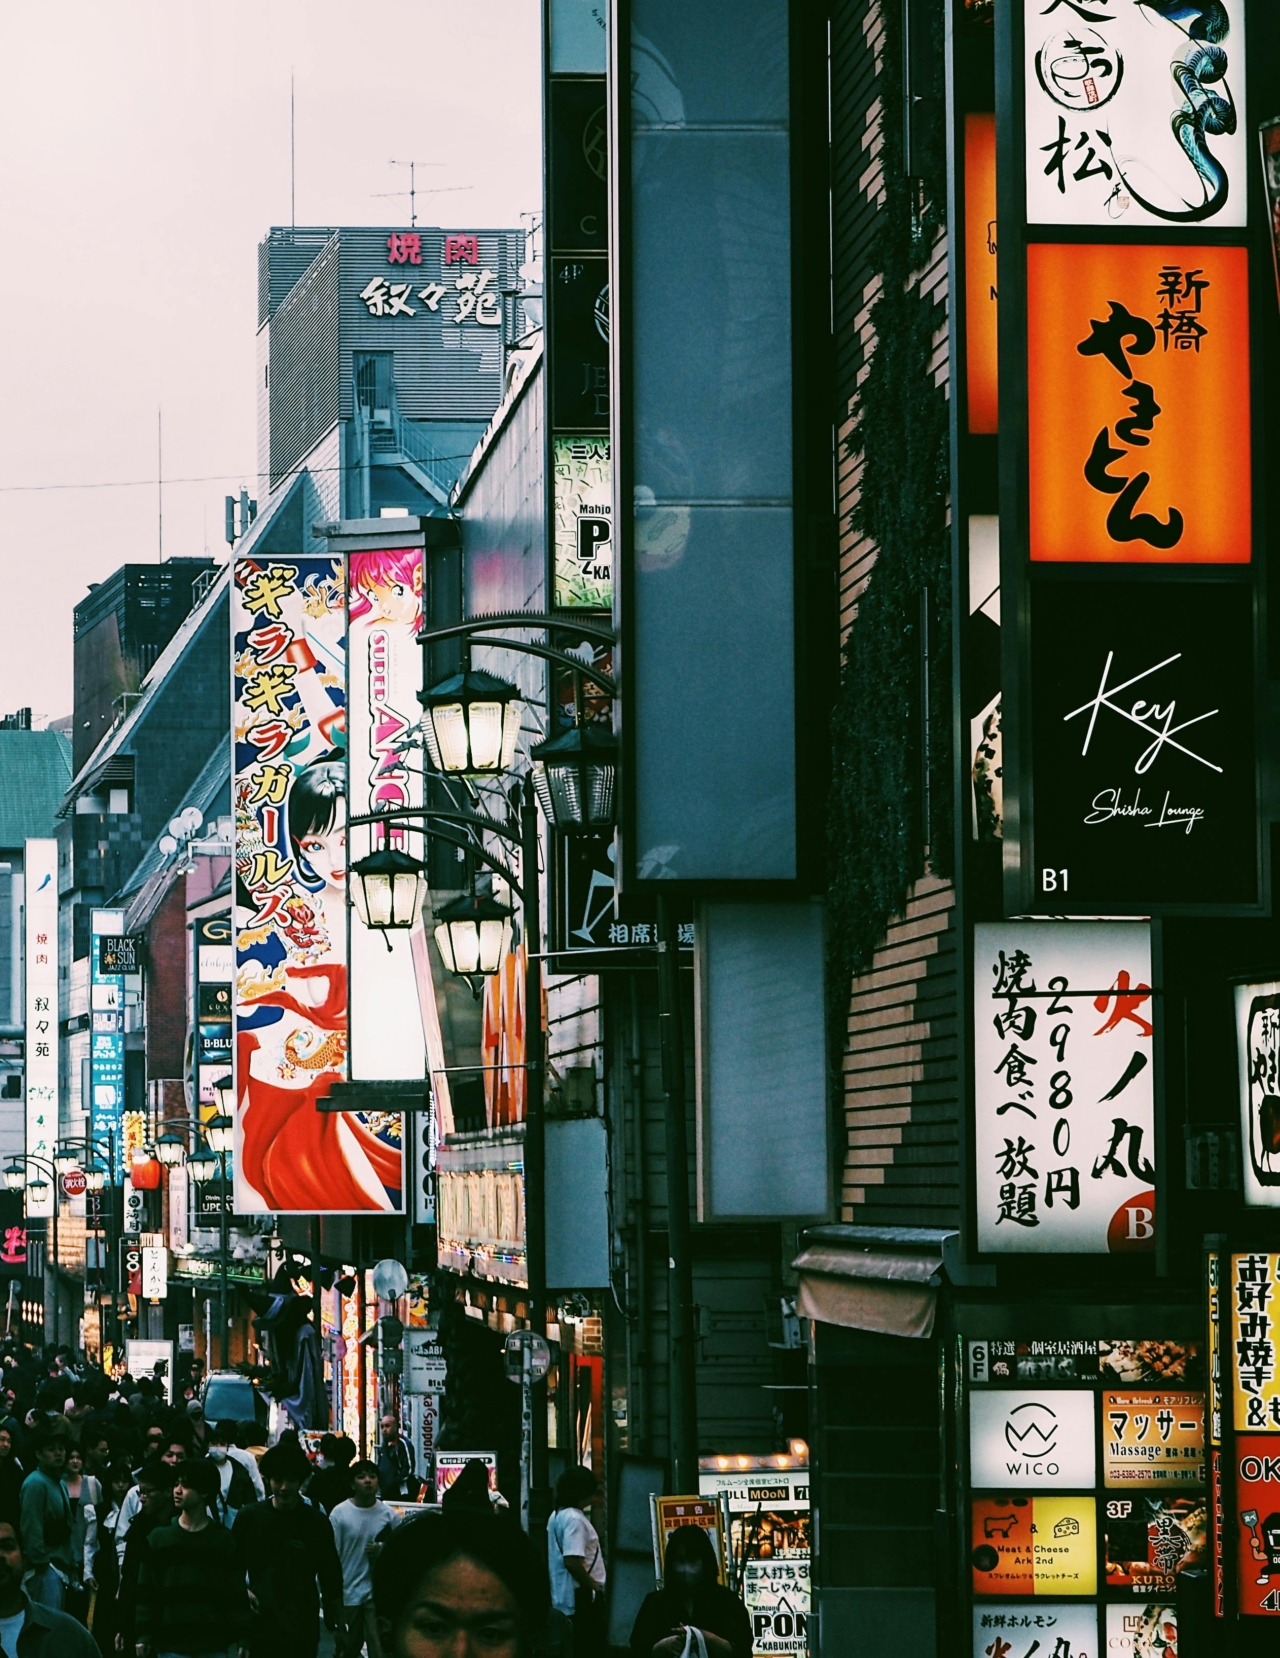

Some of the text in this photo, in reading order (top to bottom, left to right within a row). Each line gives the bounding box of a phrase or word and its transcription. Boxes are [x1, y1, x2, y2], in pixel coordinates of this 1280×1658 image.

[387, 232, 478, 265] 焼肉
[359, 269, 503, 326] 叙々苑
[1154, 265, 1210, 353] 新橋
[1076, 300, 1185, 549] やきとん
[580, 504, 611, 515] Mahjo
[1063, 650, 1223, 775] Key
[243, 562, 299, 930] ギラギラガールズ
[375, 706, 406, 851] ANGE
[1083, 788, 1205, 834] Shisha Lounge
[1042, 868, 1068, 892] B1
[36, 933, 48, 965] 焼肉
[106, 938, 136, 951] BLACK
[608, 922, 696, 945] 相席場
[117, 951, 136, 965] SUN
[34, 996, 50, 1057] 叙々苑
[992, 949, 1040, 1228] 焼肉食べ放題
[1044, 976, 1081, 1210] 2980円
[1090, 969, 1156, 1186] 火ノ丸
[149, 1249, 161, 1295] とんかつ
[1235, 1254, 1274, 1396] お好み焼き
[972, 1345, 985, 1378] 6F
[1109, 1409, 1205, 1442] マッサー
[1110, 1442, 1161, 1461] Massage
[1006, 1462, 1060, 1476] WICO
[1107, 1501, 1131, 1518] 3F
[997, 1545, 1021, 1554] Meat
[1034, 1545, 1070, 1554] Cheese
[1014, 1556, 1054, 1565] Ark 2nd
[747, 1581, 802, 1594] まーじゃん
[981, 1614, 1058, 1629] 新鮮ホルモン
